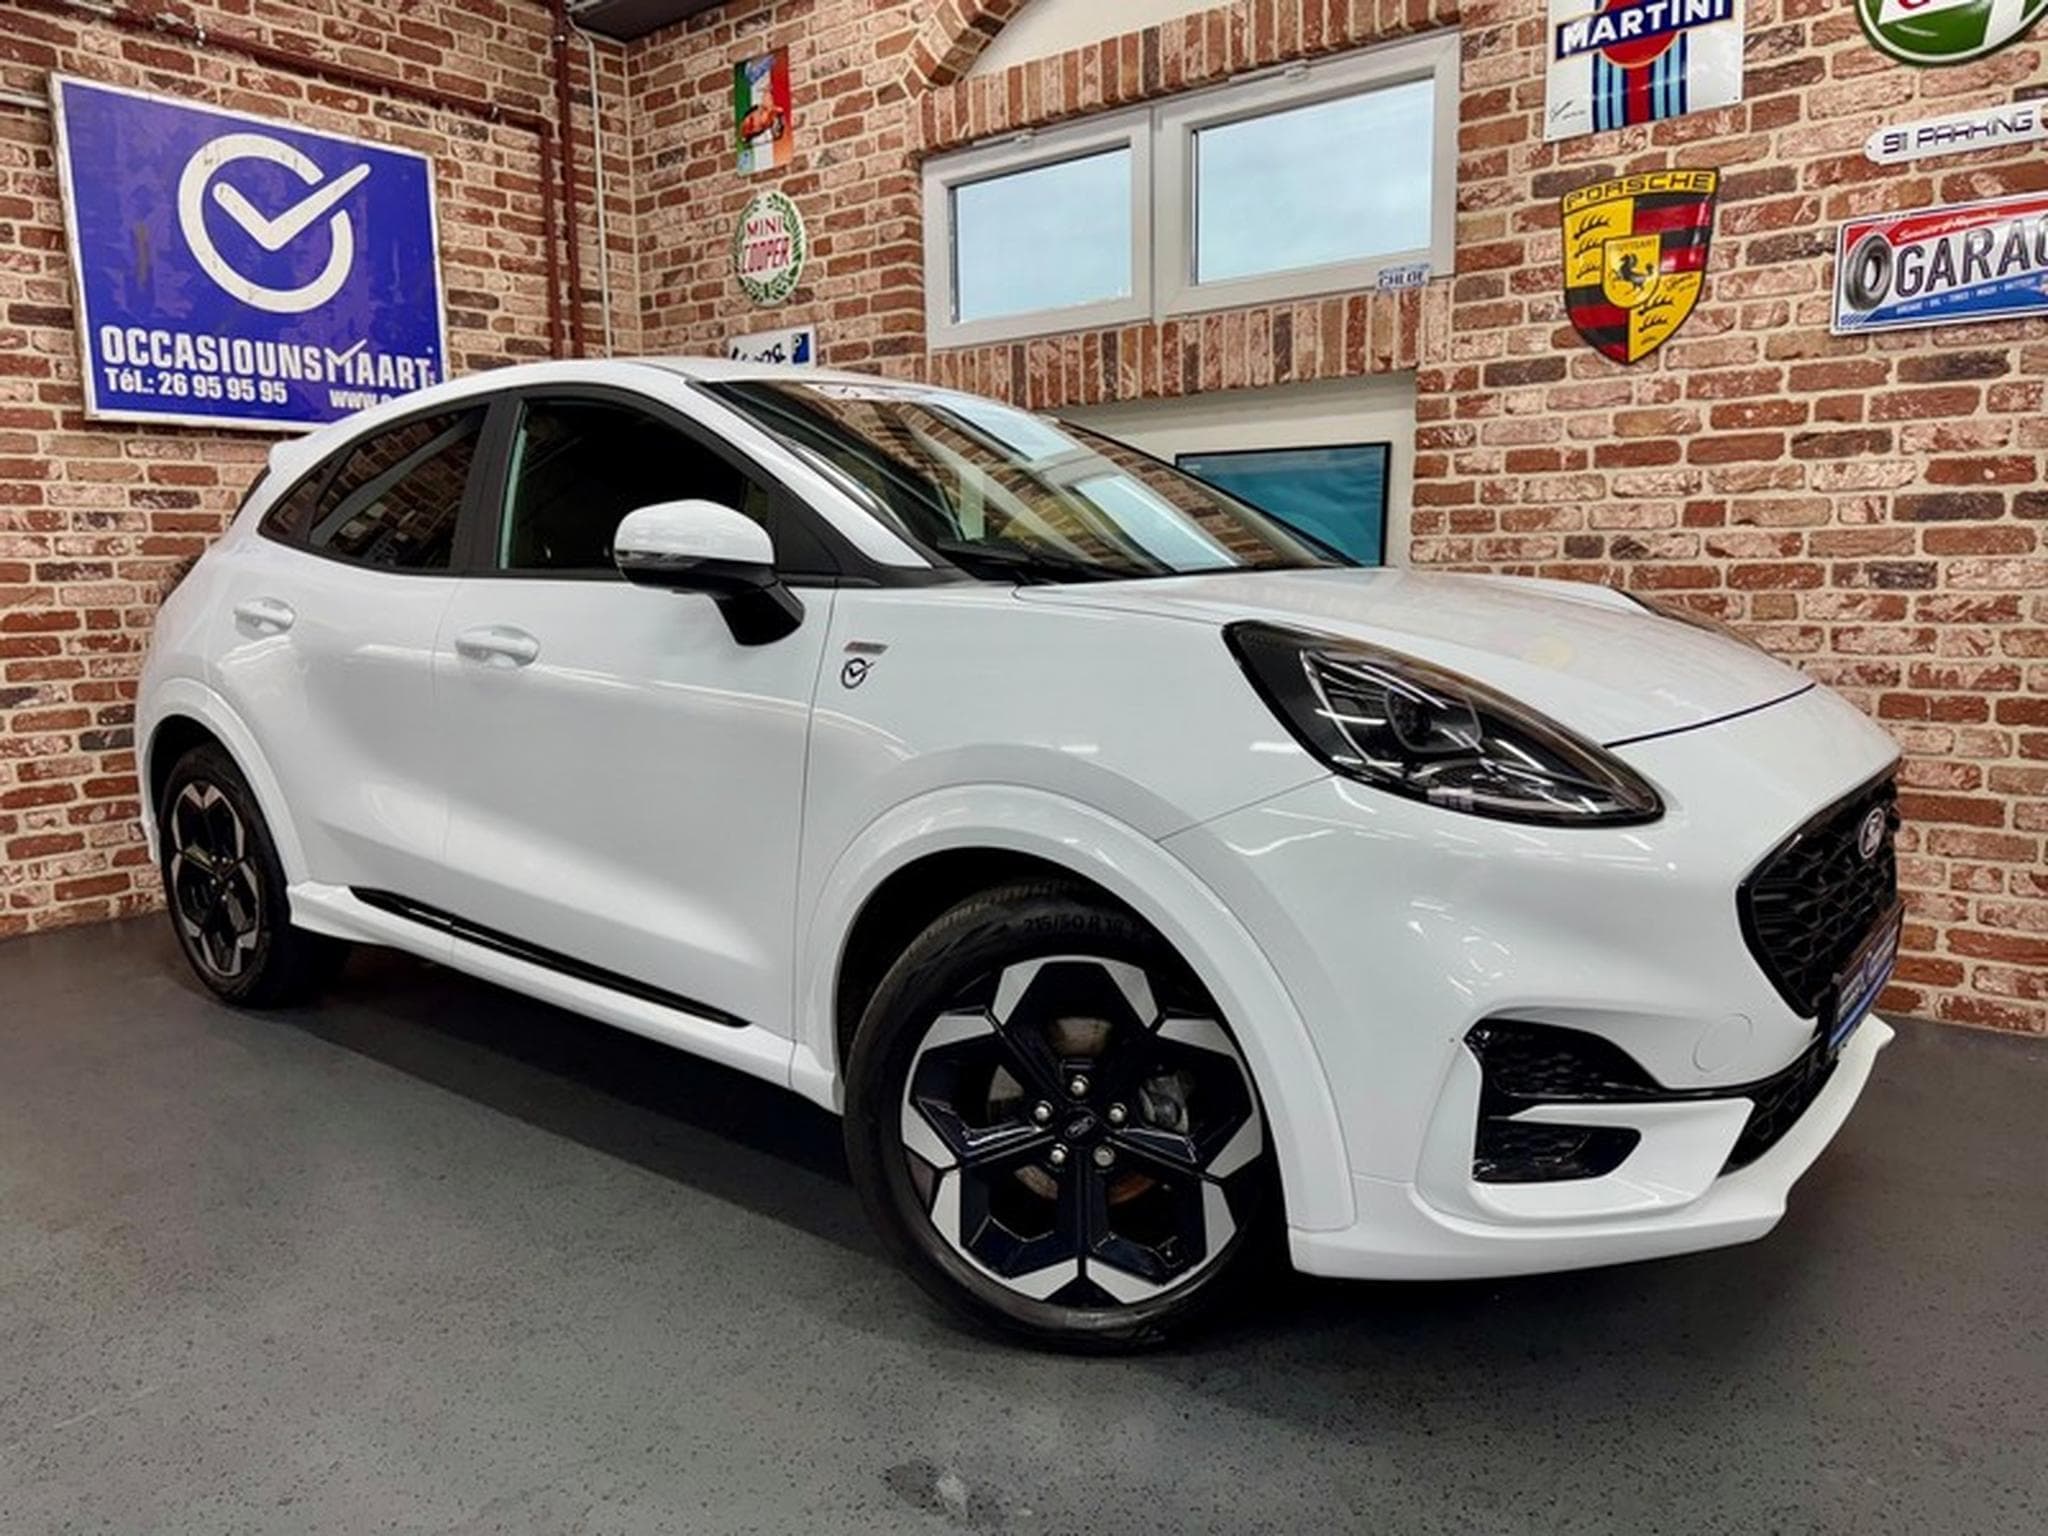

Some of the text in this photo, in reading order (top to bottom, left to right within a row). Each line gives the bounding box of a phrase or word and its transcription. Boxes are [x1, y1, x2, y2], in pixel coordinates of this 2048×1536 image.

[1562, 0, 1726, 53] MARTINI
[1916, 110, 2034, 148] PARKING
[1566, 173, 1712, 209] PORSCHE
[747, 215, 783, 237] MINI
[742, 236, 790, 275] COOPER
[104, 367, 288, 405] Tél.: 26 95 95 95
[329, 389, 393, 409] www
